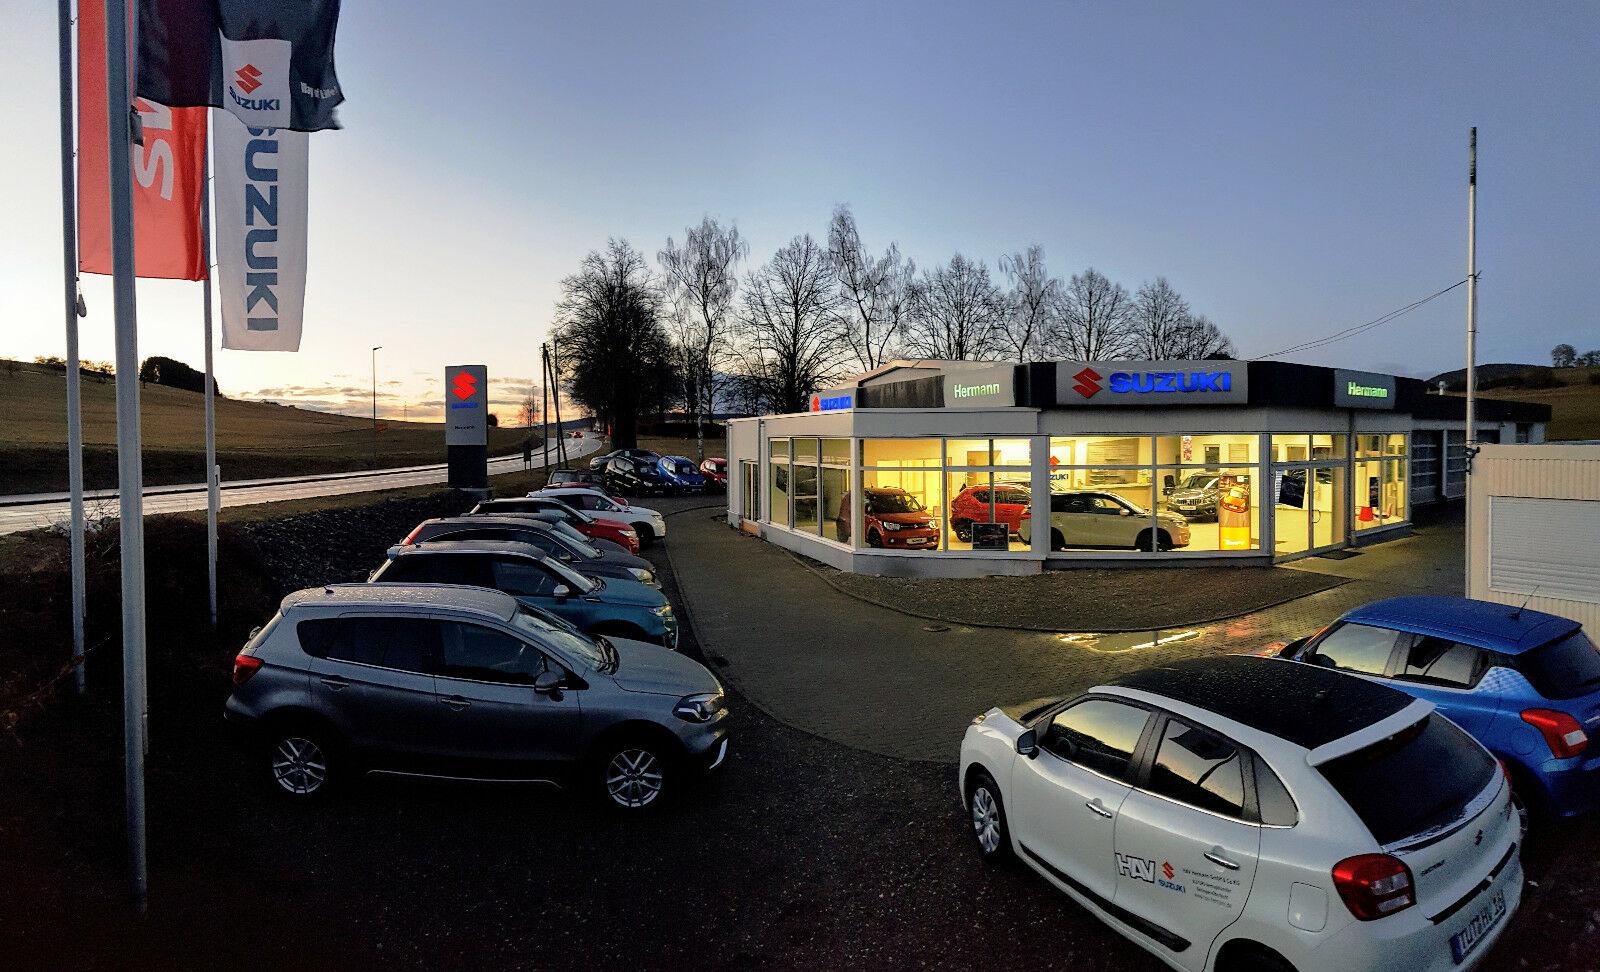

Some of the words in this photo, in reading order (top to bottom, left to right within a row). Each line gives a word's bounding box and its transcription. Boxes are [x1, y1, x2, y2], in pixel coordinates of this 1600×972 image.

[229, 85, 280, 112] SUZUKI
[245, 127, 279, 331] UZUKI
[954, 383, 1000, 398] Hermann
[1109, 371, 1232, 393] SUZUKI
[1347, 381, 1388, 398] Hermann
[1115, 852, 1156, 883] HAV
